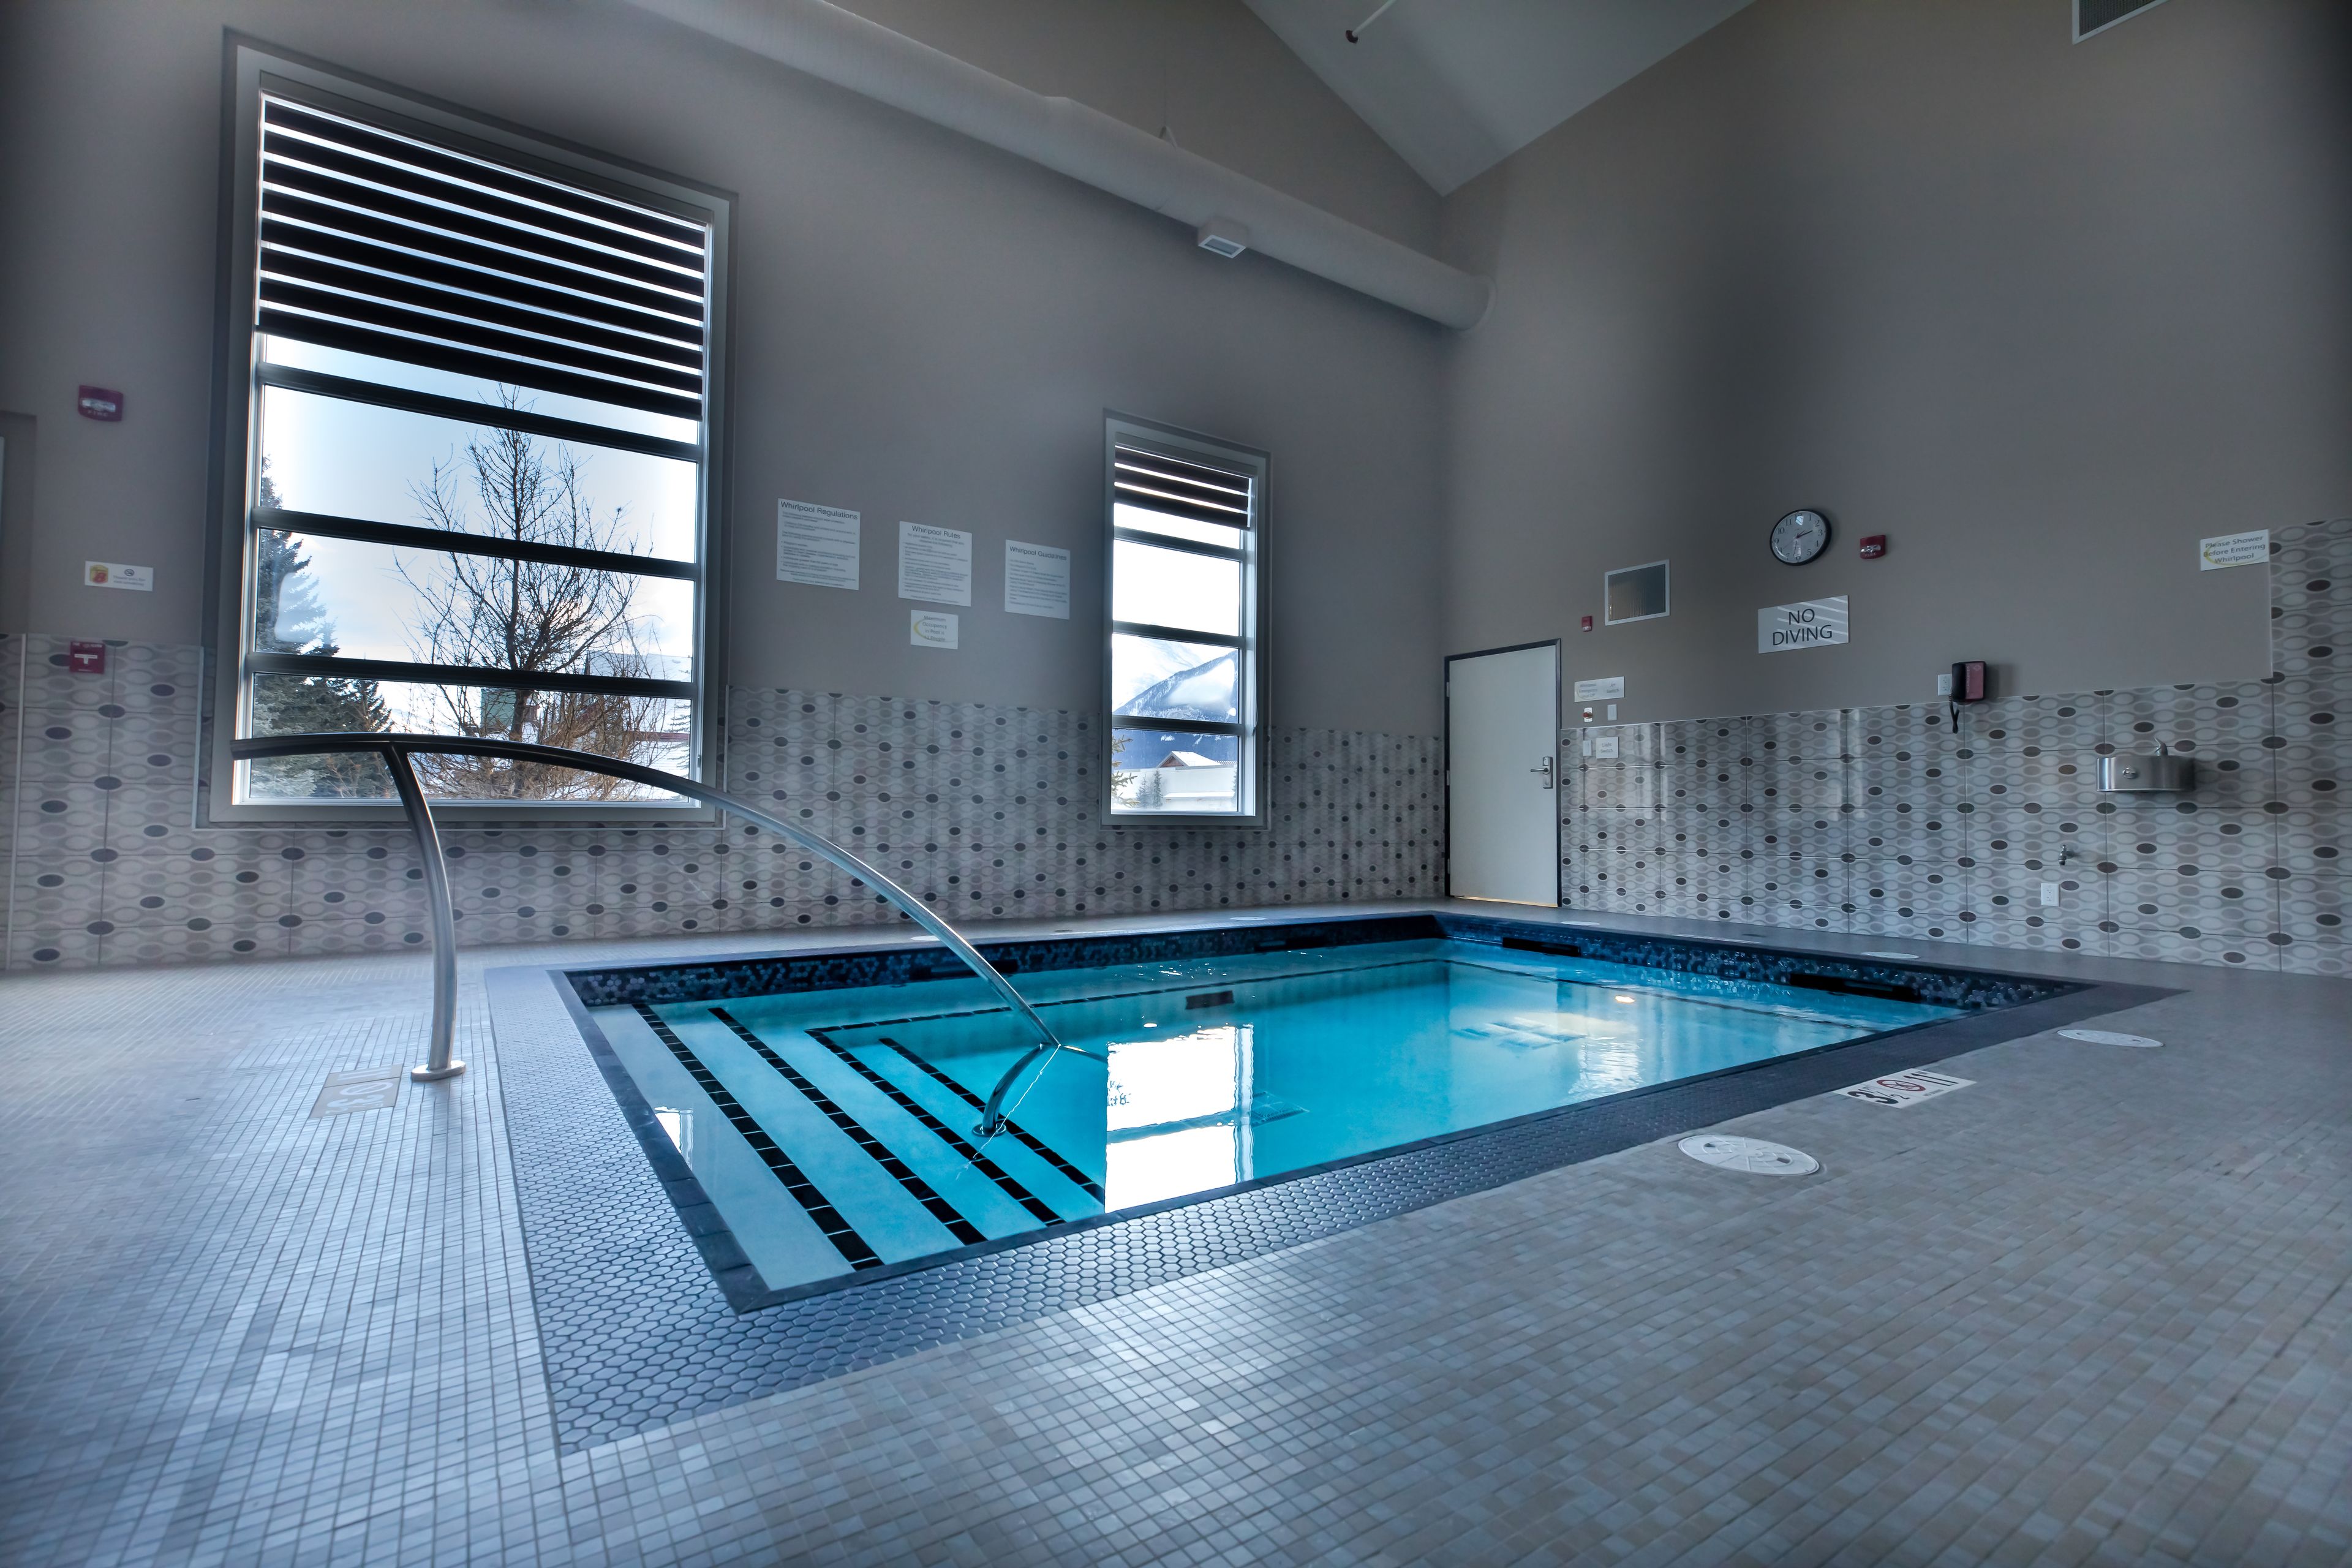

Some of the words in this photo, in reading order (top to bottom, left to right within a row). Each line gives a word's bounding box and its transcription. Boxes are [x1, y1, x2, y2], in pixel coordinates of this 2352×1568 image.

[781, 500, 815, 512] Whirlpool
[817, 508, 858, 519] Regulations
[911, 526, 941, 535] Whirlpool
[944, 530, 961, 539] Rules
[2232, 536, 2263, 545] Shower
[1009, 546, 1036, 555] Whirlpool
[1038, 551, 1068, 560] Guidelines
[2203, 549, 2229, 557] Before
[2231, 544, 2266, 553] Entering
[2214, 552, 2254, 564] Whirlpool
[1789, 608, 1815, 625] NO
[1773, 624, 1833, 646] DIVING
